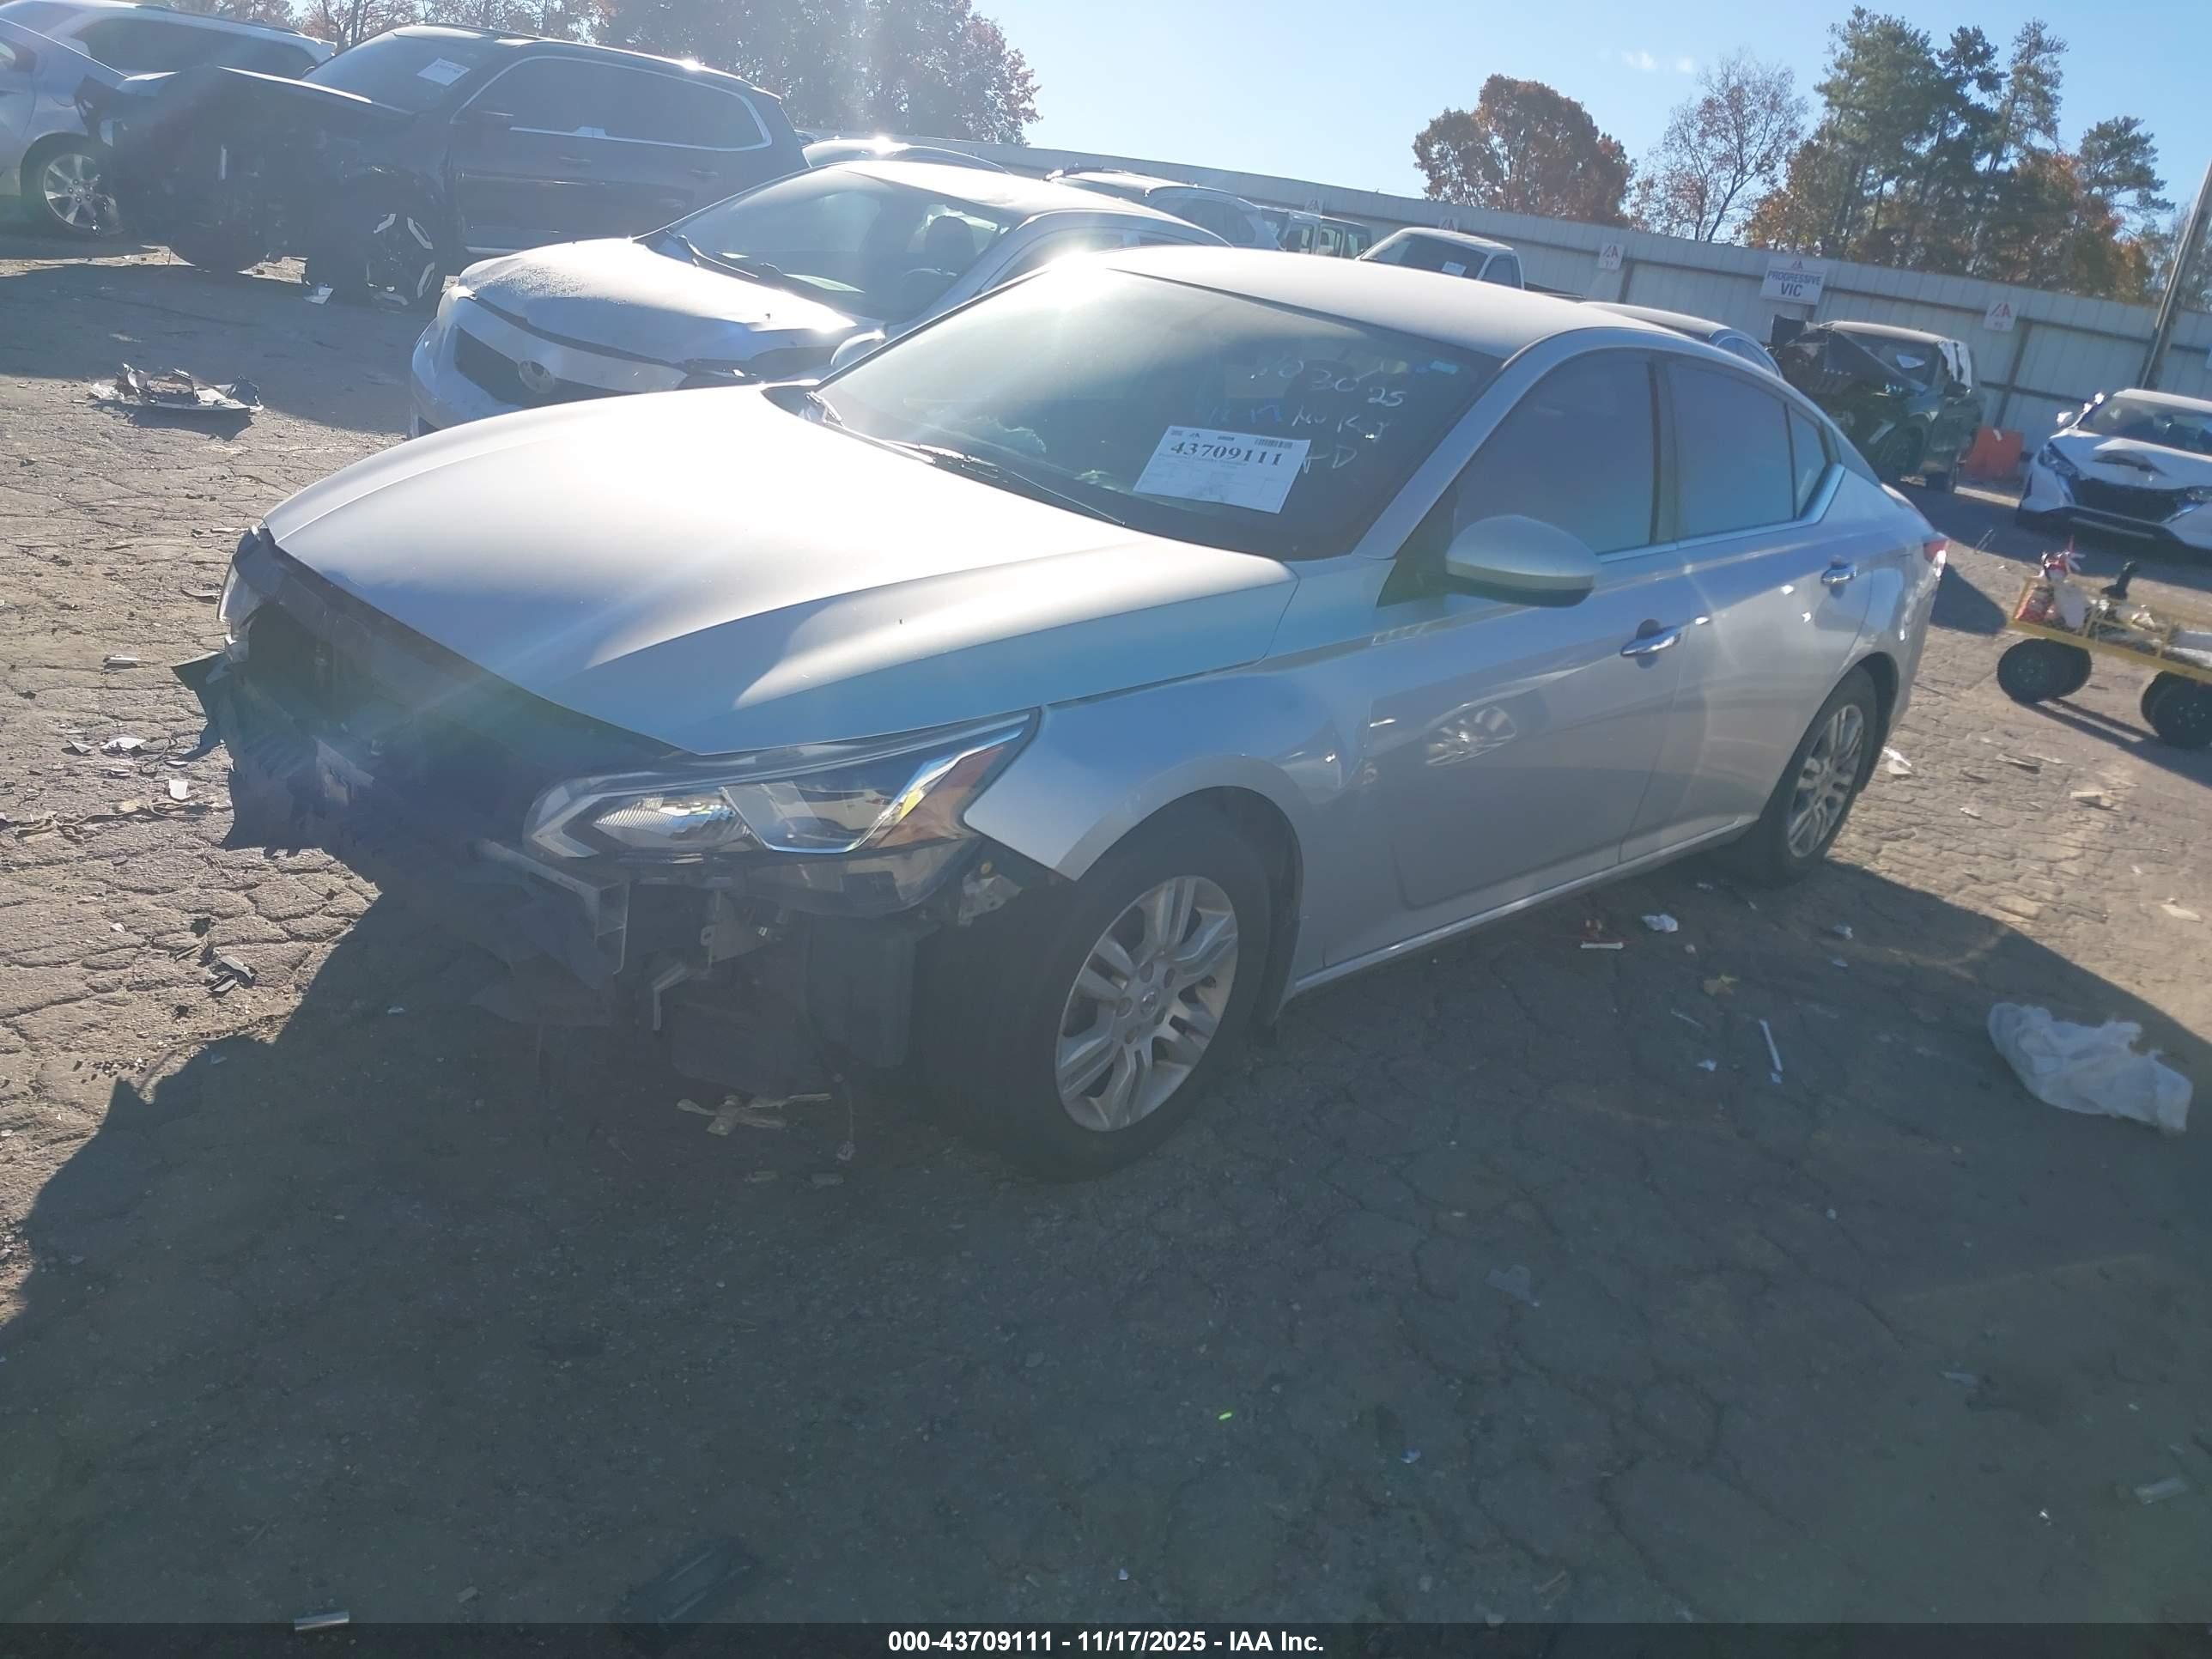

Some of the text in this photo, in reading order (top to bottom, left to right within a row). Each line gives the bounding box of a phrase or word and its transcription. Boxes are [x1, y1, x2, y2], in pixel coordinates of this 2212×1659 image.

[1767, 270, 1821, 286] PROGRESSIVE
[1781, 283, 1802, 297] VIC
[1170, 441, 1283, 466] 43709111
